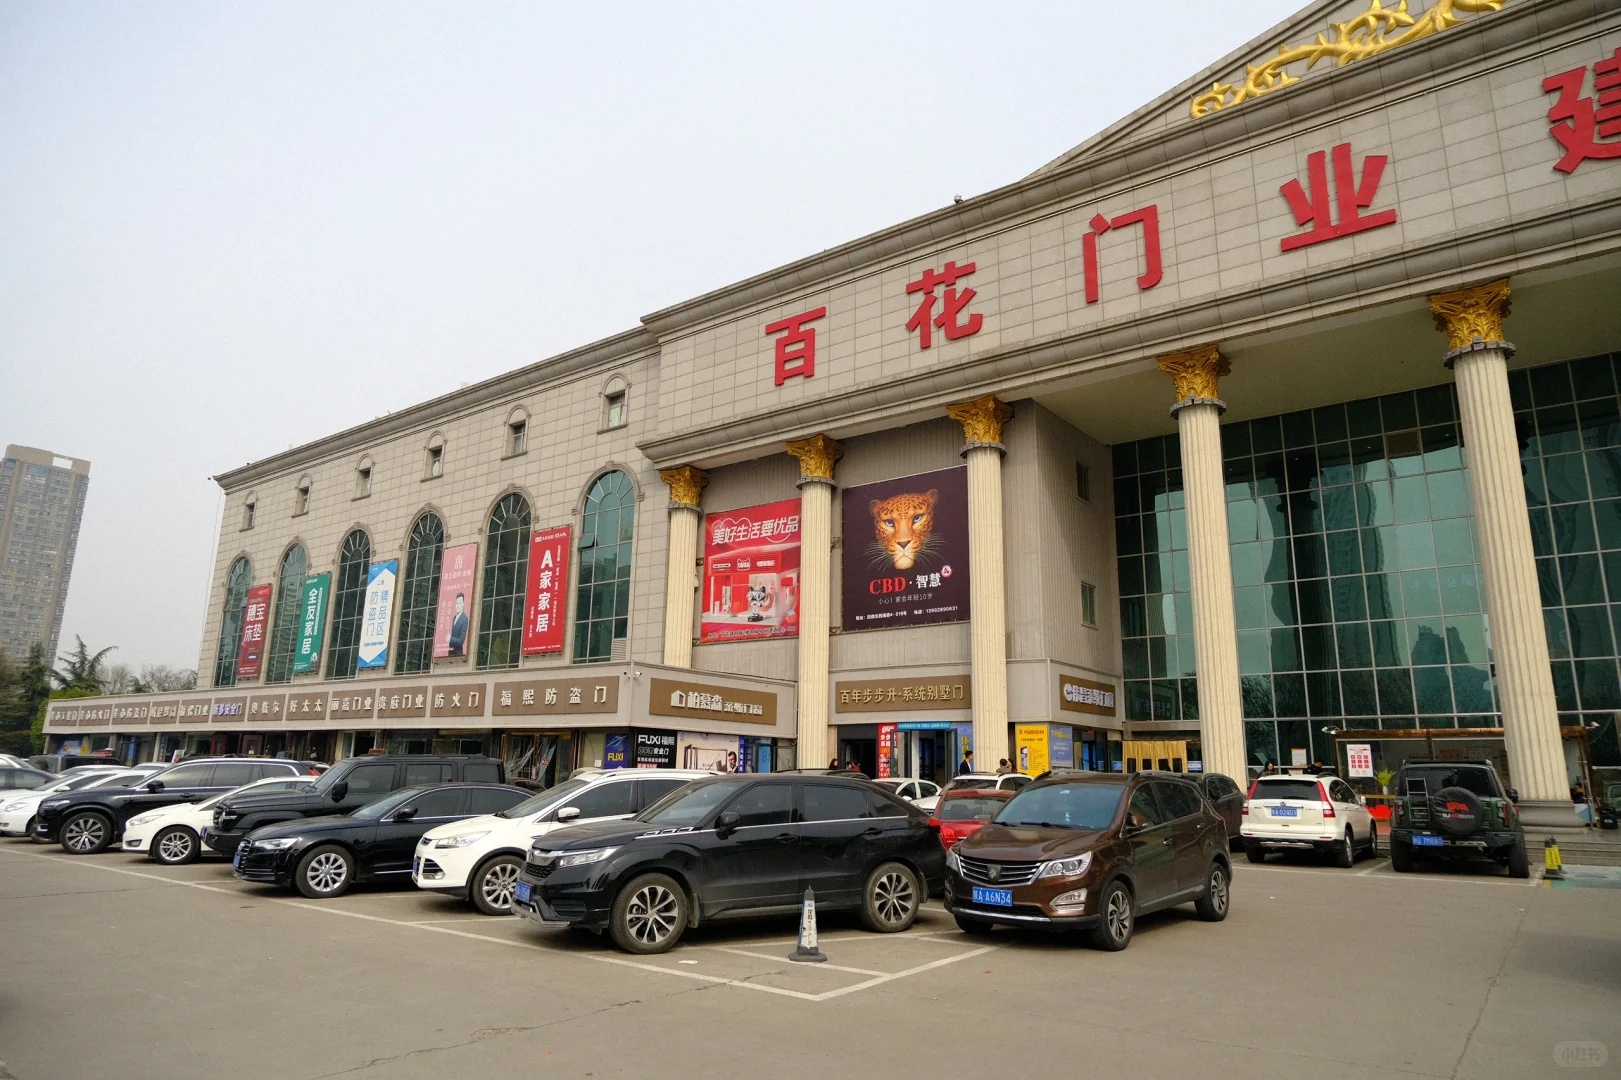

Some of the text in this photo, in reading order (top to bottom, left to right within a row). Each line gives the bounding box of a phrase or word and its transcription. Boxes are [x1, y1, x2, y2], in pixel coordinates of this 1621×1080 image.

[712, 515, 800, 546] 美好生活要优品
[536, 550, 553, 633] A家家居
[301, 588, 318, 654] 全友家居
[366, 591, 379, 637] 防盗门
[376, 590, 389, 636] 精品区
[331, 697, 373, 711] 丽嘉门业
[377, 694, 424, 710] 贵府门业
[434, 692, 479, 708] 防火门
[500, 686, 607, 706] 福熙防盗门
[839, 684, 963, 704] 百年步步升·系统别墅门
[288, 699, 323, 714] 好太太
[638, 734, 661, 745] FUXI
[607, 752, 624, 762] FUXI
